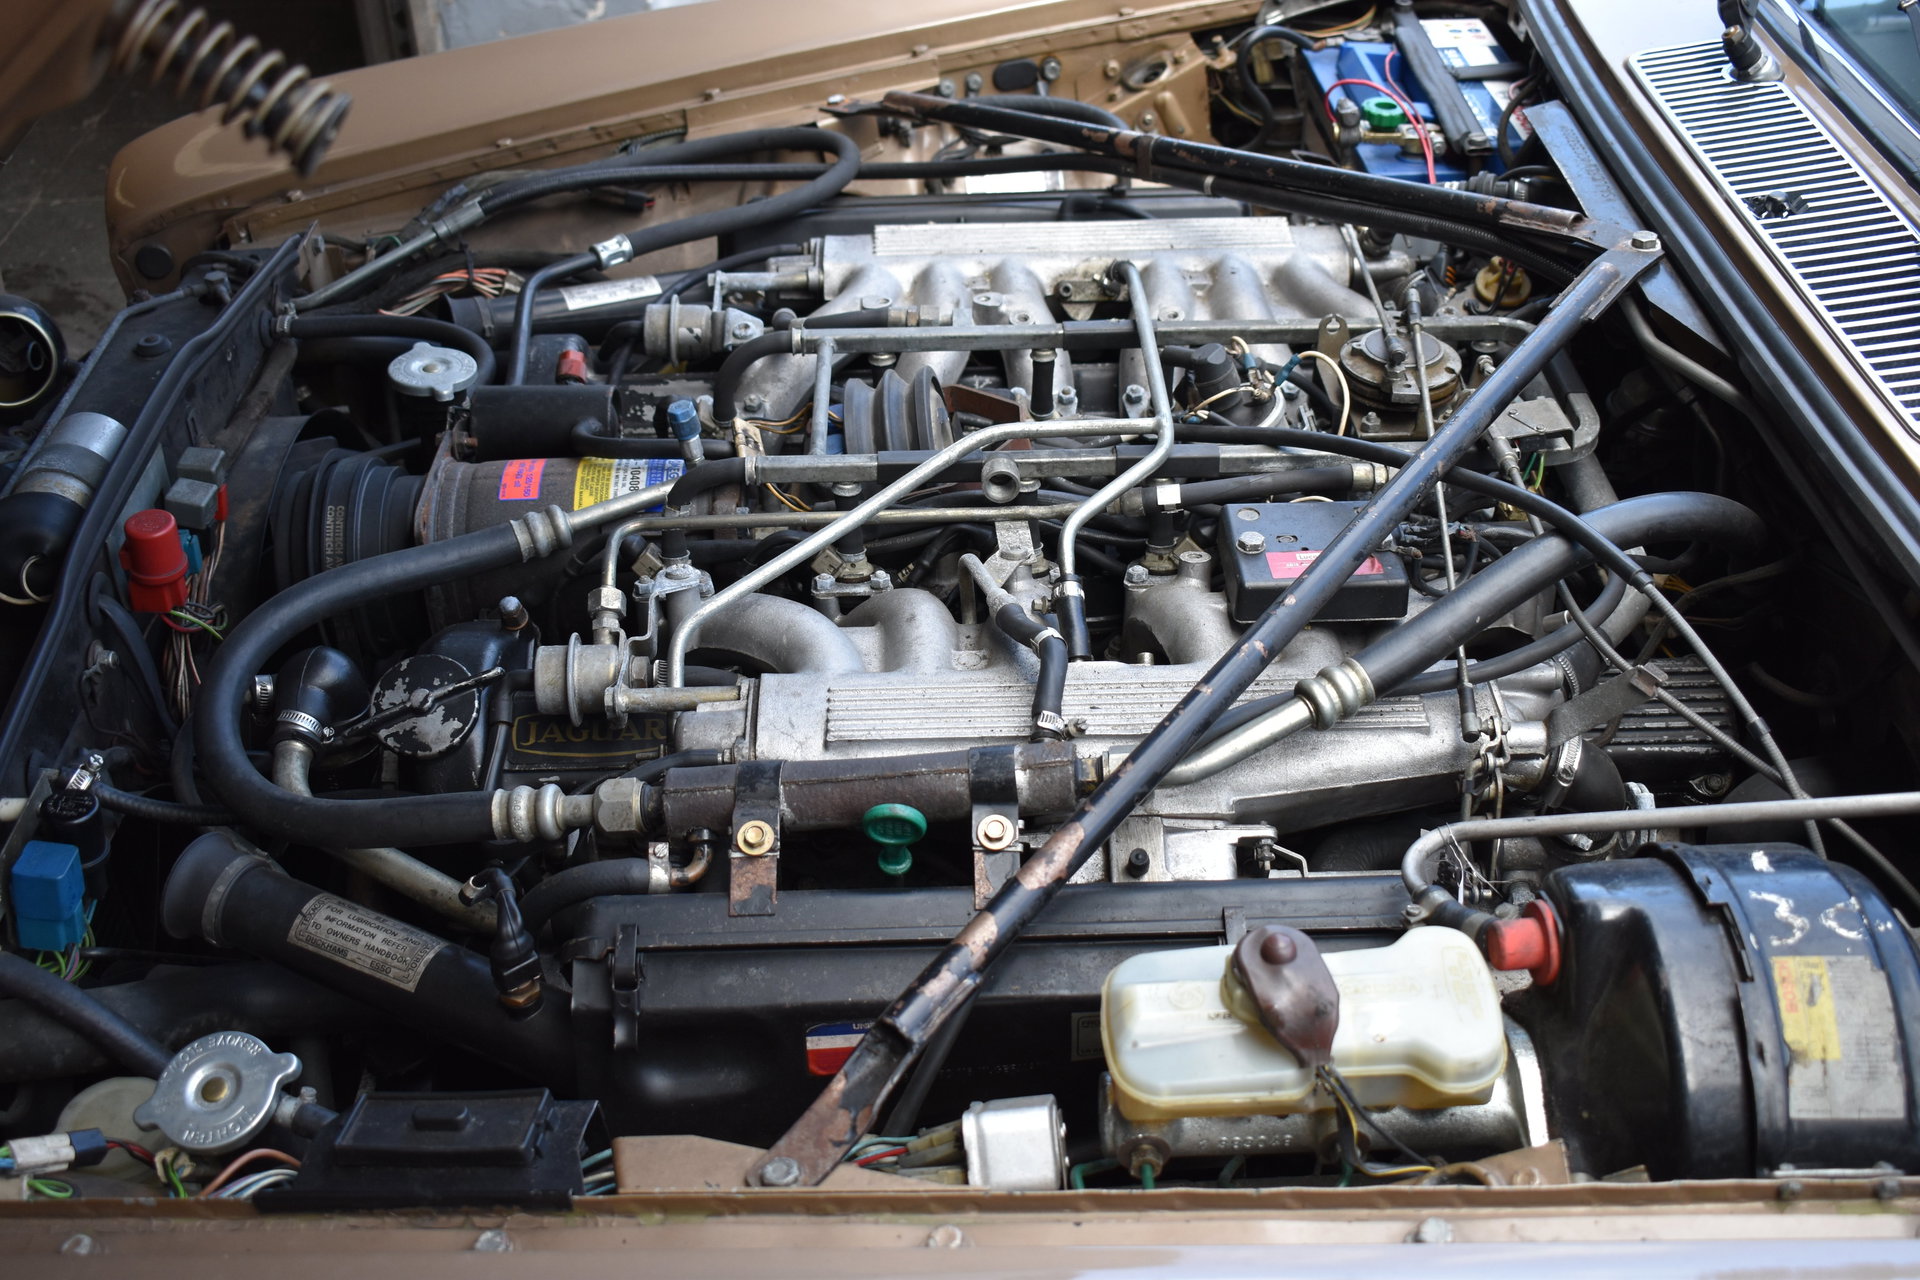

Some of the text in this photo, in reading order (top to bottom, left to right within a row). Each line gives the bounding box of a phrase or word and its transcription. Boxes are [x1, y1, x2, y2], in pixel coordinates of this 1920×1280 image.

[325, 505, 335, 554] CONTITECH
[335, 505, 345, 554] CONTITECH
[520, 718, 668, 746] JAGUAR
[310, 921, 409, 966] TO OWNERS HANDBOOK
[324, 914, 376, 940] INFORMATION
[381, 938, 408, 952] REFER
[326, 905, 422, 946] FOR LUBRICATION AND
[305, 935, 392, 975] DUCKHAMS ESSO
